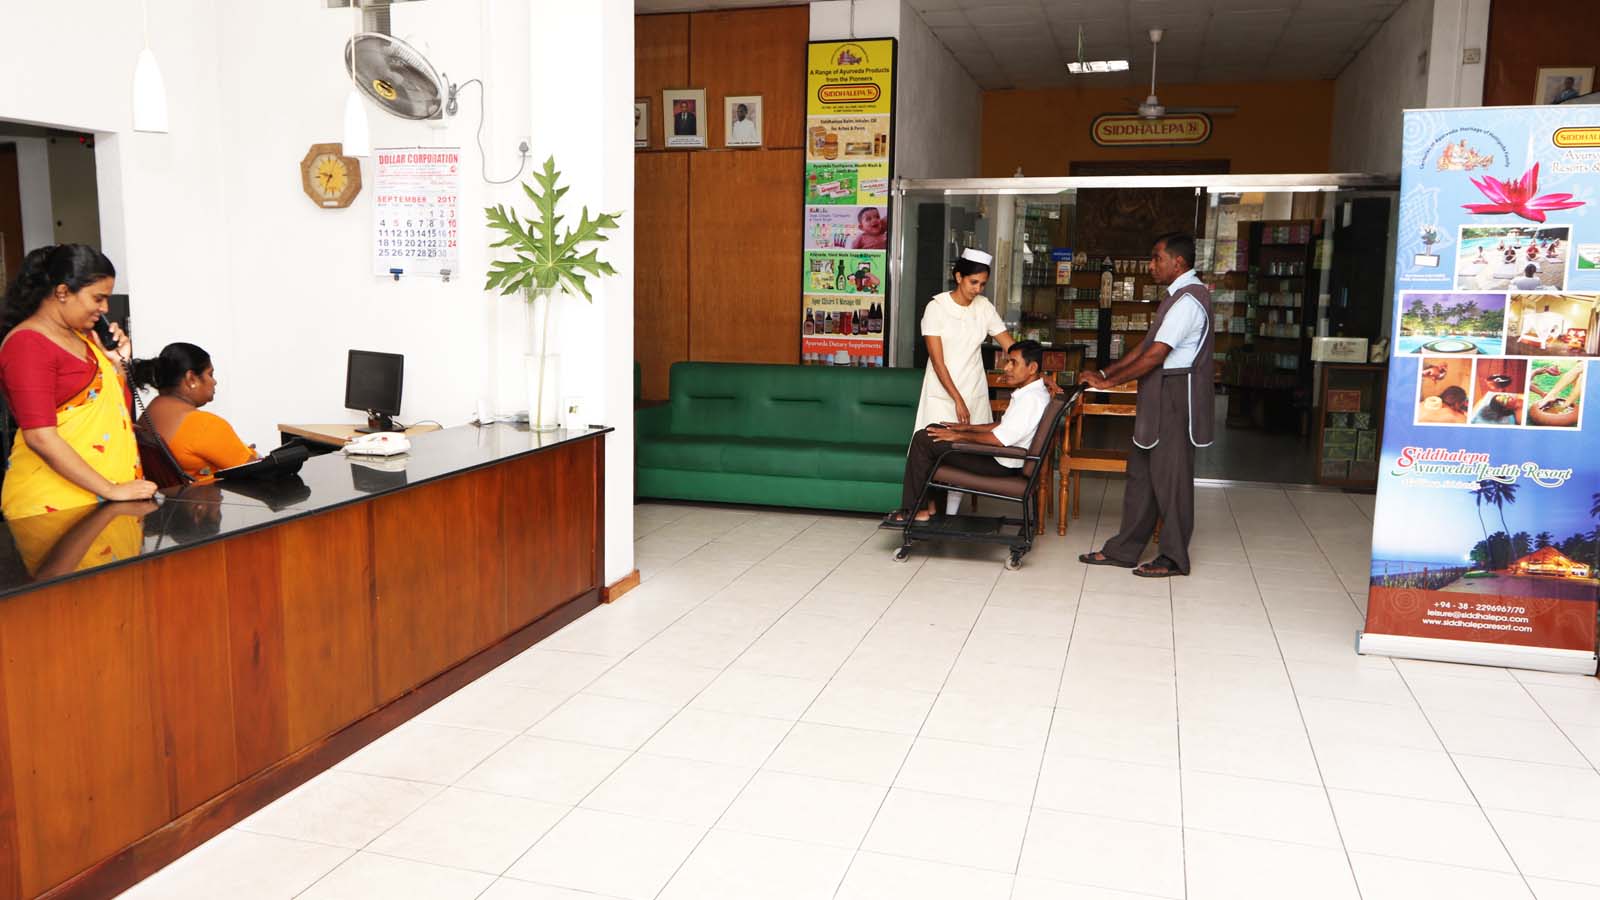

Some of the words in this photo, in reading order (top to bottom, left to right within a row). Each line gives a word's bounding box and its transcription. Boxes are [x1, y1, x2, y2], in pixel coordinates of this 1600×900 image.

[824, 89, 866, 97] SIDDHALEPA
[1103, 124, 1184, 136] SIDDHALEPA
[379, 155, 406, 164] DOLLAR
[407, 153, 458, 164] CORPORATION
[1566, 149, 1600, 160] Ayurv
[377, 195, 427, 203] SEPTEMBER
[379, 230, 389, 238] 11
[392, 230, 402, 238] 12
[405, 230, 415, 238] 13
[416, 230, 426, 238] 14
[428, 230, 436, 238] 15
[438, 230, 447, 238] 16
[448, 230, 456, 238] 17
[379, 249, 389, 257] 25
[392, 249, 403, 257] 26
[405, 249, 415, 257] 27
[417, 249, 426, 257] 28
[428, 249, 437, 257] 29
[438, 249, 447, 257] 30
[1397, 446, 1489, 468] Siddhalepa
[1392, 462, 1473, 477] Ayurveda
[1473, 463, 1520, 484] Health
[1522, 462, 1572, 488] Resort
[1458, 602, 1468, 610] 38
[1476, 603, 1525, 614] 2296967/70
[1427, 609, 1529, 623] leisure@siddhalepa.com
[1422, 618, 1533, 632] www.siddhaleparesort.com
